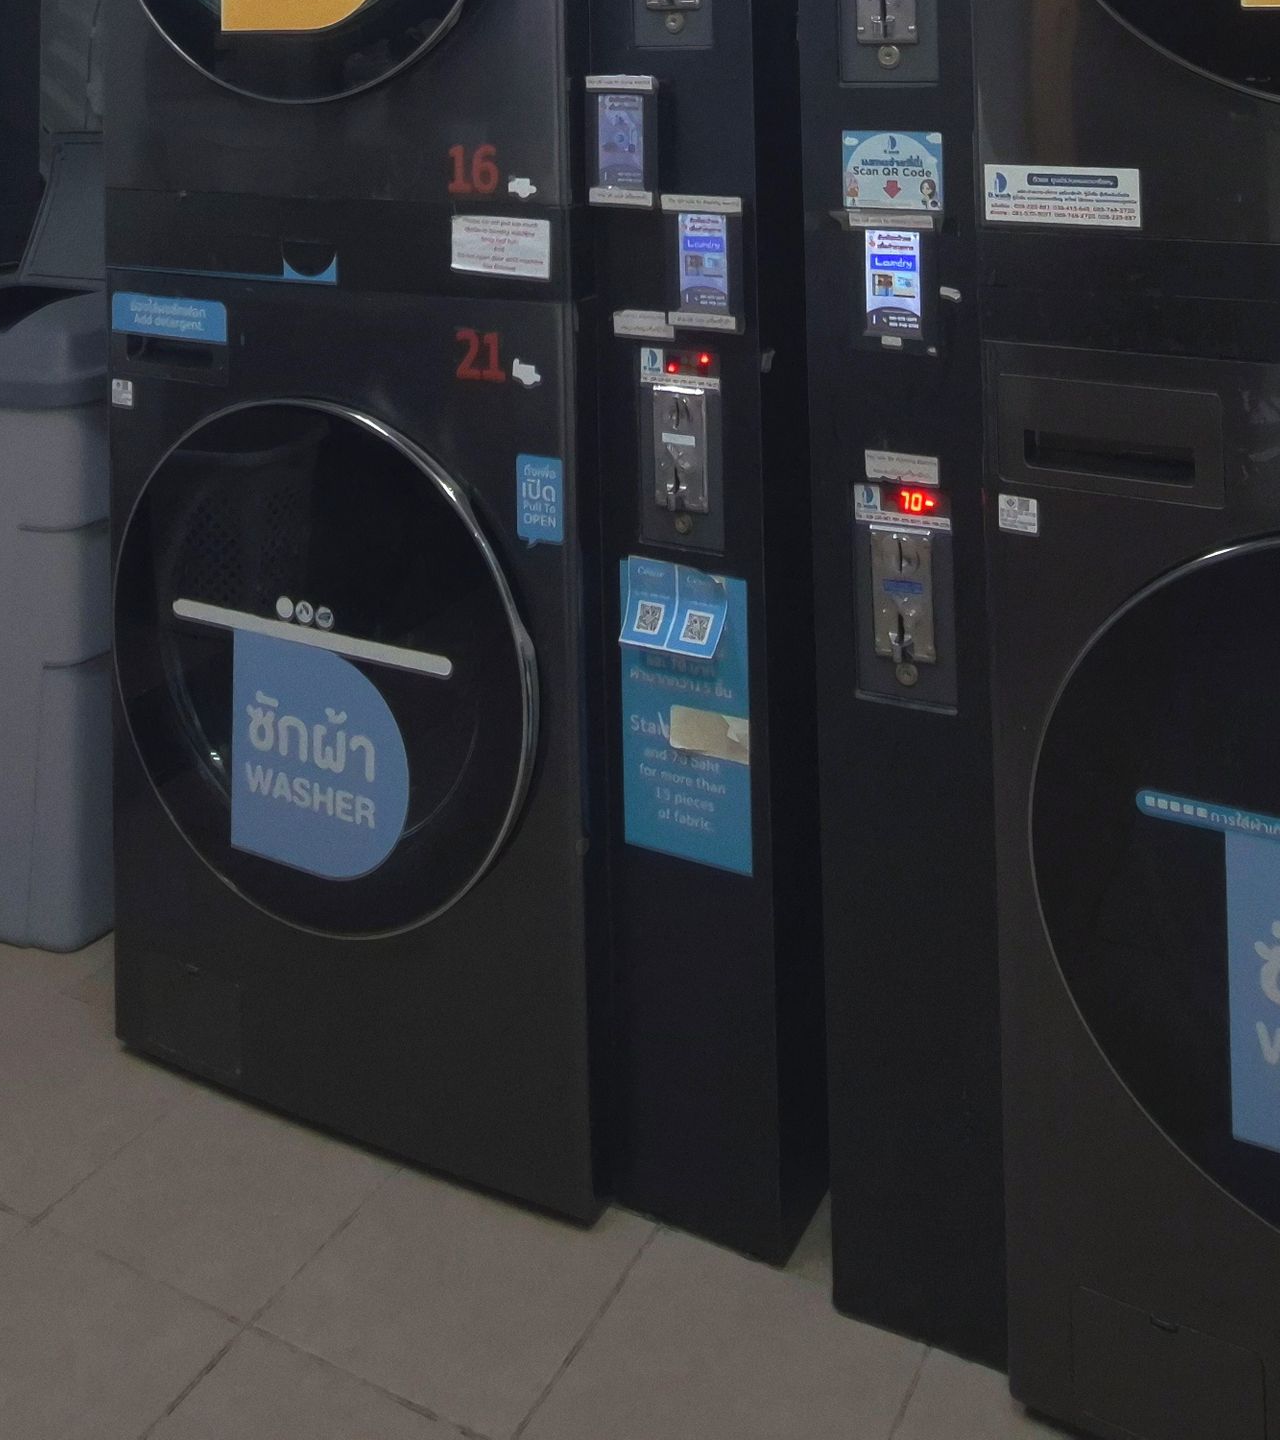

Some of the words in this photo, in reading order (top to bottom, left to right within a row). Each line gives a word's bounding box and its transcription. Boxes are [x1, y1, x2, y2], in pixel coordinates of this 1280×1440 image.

[448, 143, 499, 193] 16
[853, 166, 879, 176] Scan
[882, 167, 899, 177] QR
[903, 167, 932, 178] Code
[456, 328, 506, 382] 21
[522, 479, 556, 503] เปิด
[524, 513, 556, 528] OPEN
[246, 690, 376, 783] ซักผ้า
[640, 762, 656, 777] for
[660, 770, 693, 786] more
[696, 775, 726, 794] than
[246, 761, 376, 829] WASHER
[674, 793, 714, 812] pieces
[658, 808, 671, 820] of
